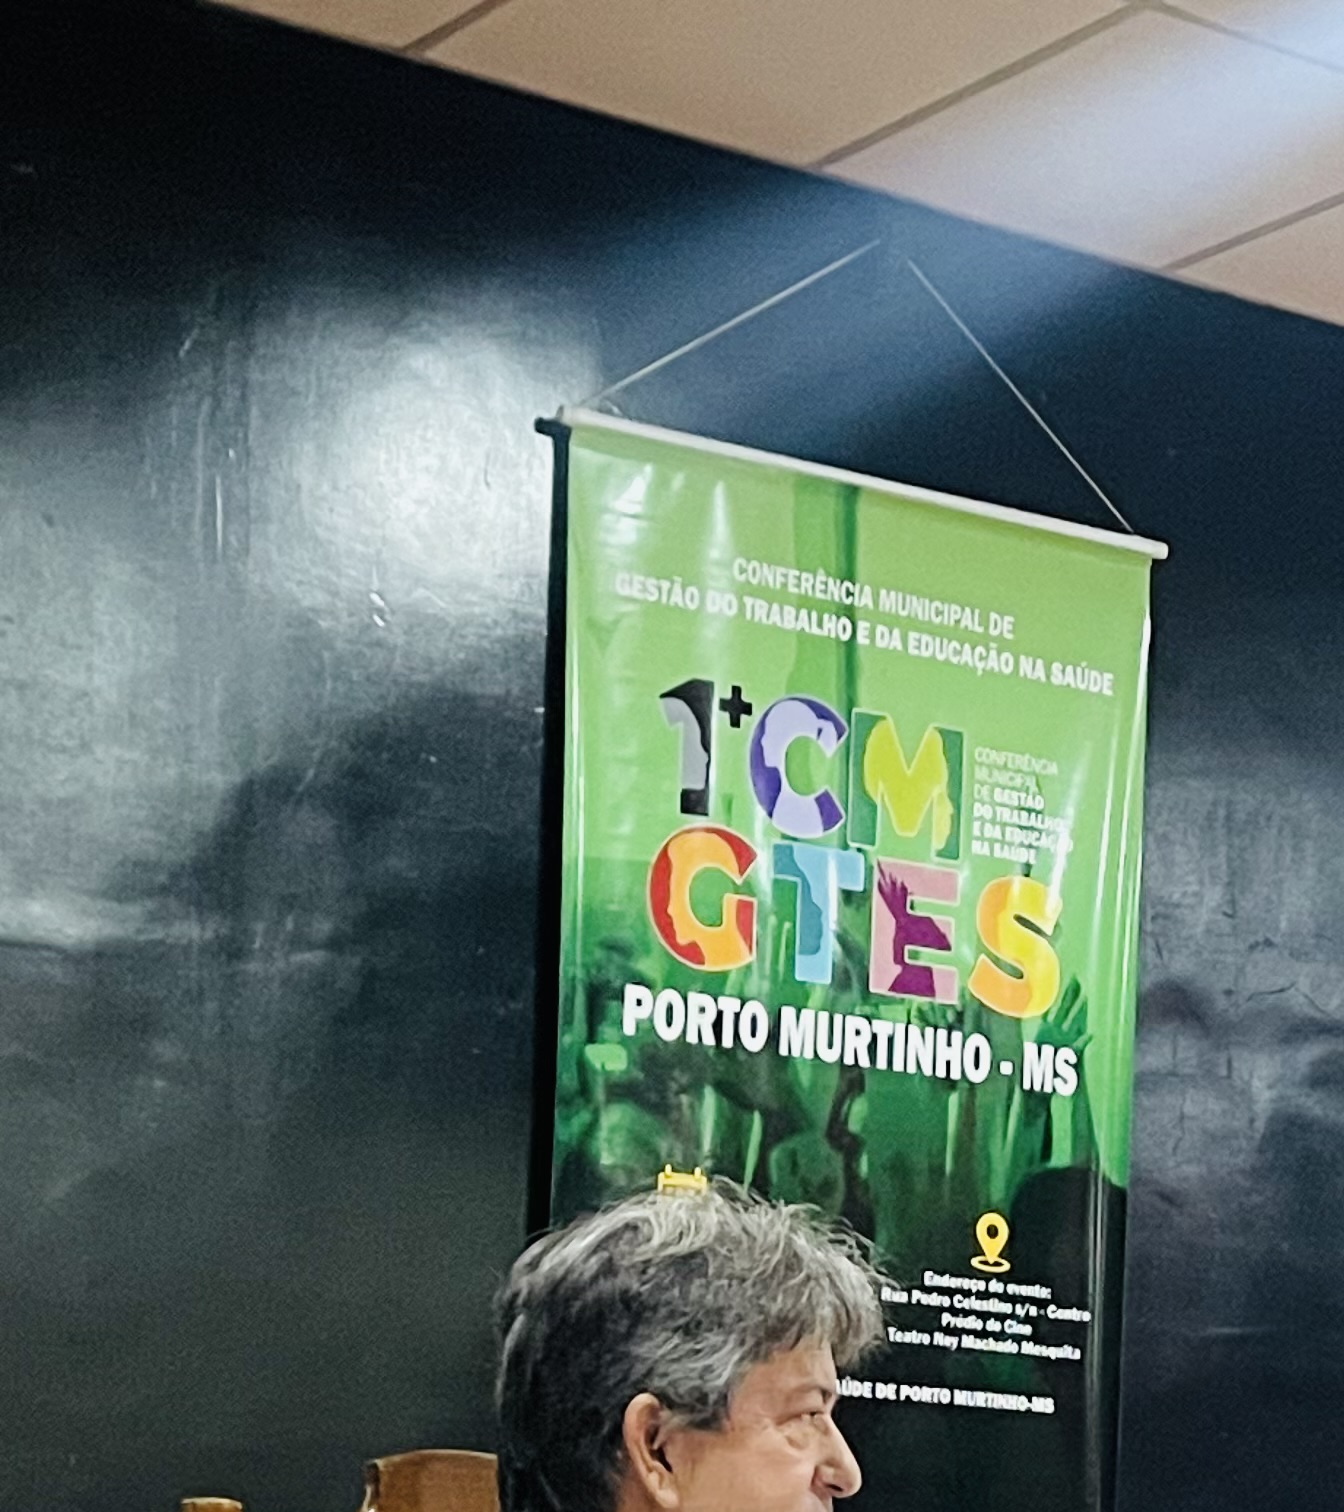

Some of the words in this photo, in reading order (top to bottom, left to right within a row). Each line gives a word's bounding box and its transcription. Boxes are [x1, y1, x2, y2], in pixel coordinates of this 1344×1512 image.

[733, 557, 873, 609] CONFERÊNCIA
[878, 588, 984, 633] MUNICIPAL
[988, 611, 1015, 639] DE
[615, 572, 699, 610] GESTÃO
[706, 590, 738, 617] DO
[743, 595, 853, 642] TRABALHO
[856, 619, 871, 645] E
[875, 624, 903, 651] DA
[908, 631, 1015, 676] EDUCAÇÃO
[1019, 655, 1046, 682] NA
[1050, 661, 1115, 695] SAÚDE
[973, 801, 993, 820] DO
[1005, 825, 1074, 854] EDUCAÇO
[646, 823, 1063, 1019] GTES
[622, 983, 768, 1052] PORTO
[778, 1006, 992, 1083] MURTINHO
[999, 1060, 1014, 1076] -
[1022, 1041, 1079, 1096] MS
[923, 1270, 986, 1293] Endereço
[988, 1278, 1004, 1294] do
[881, 1286, 909, 1303] Rua
[911, 1289, 951, 1307] Pedro
[953, 1293, 1013, 1314] Celestino
[1046, 1303, 1092, 1322] Centro
[941, 1311, 983, 1331] Prédio
[887, 1326, 931, 1345] Teatro
[933, 1331, 959, 1351] Ney
[961, 1334, 1019, 1354] Machado
[1021, 1340, 1081, 1359] Mesquita
[875, 1382, 897, 1400] DE
[900, 1384, 951, 1404] PORTO
